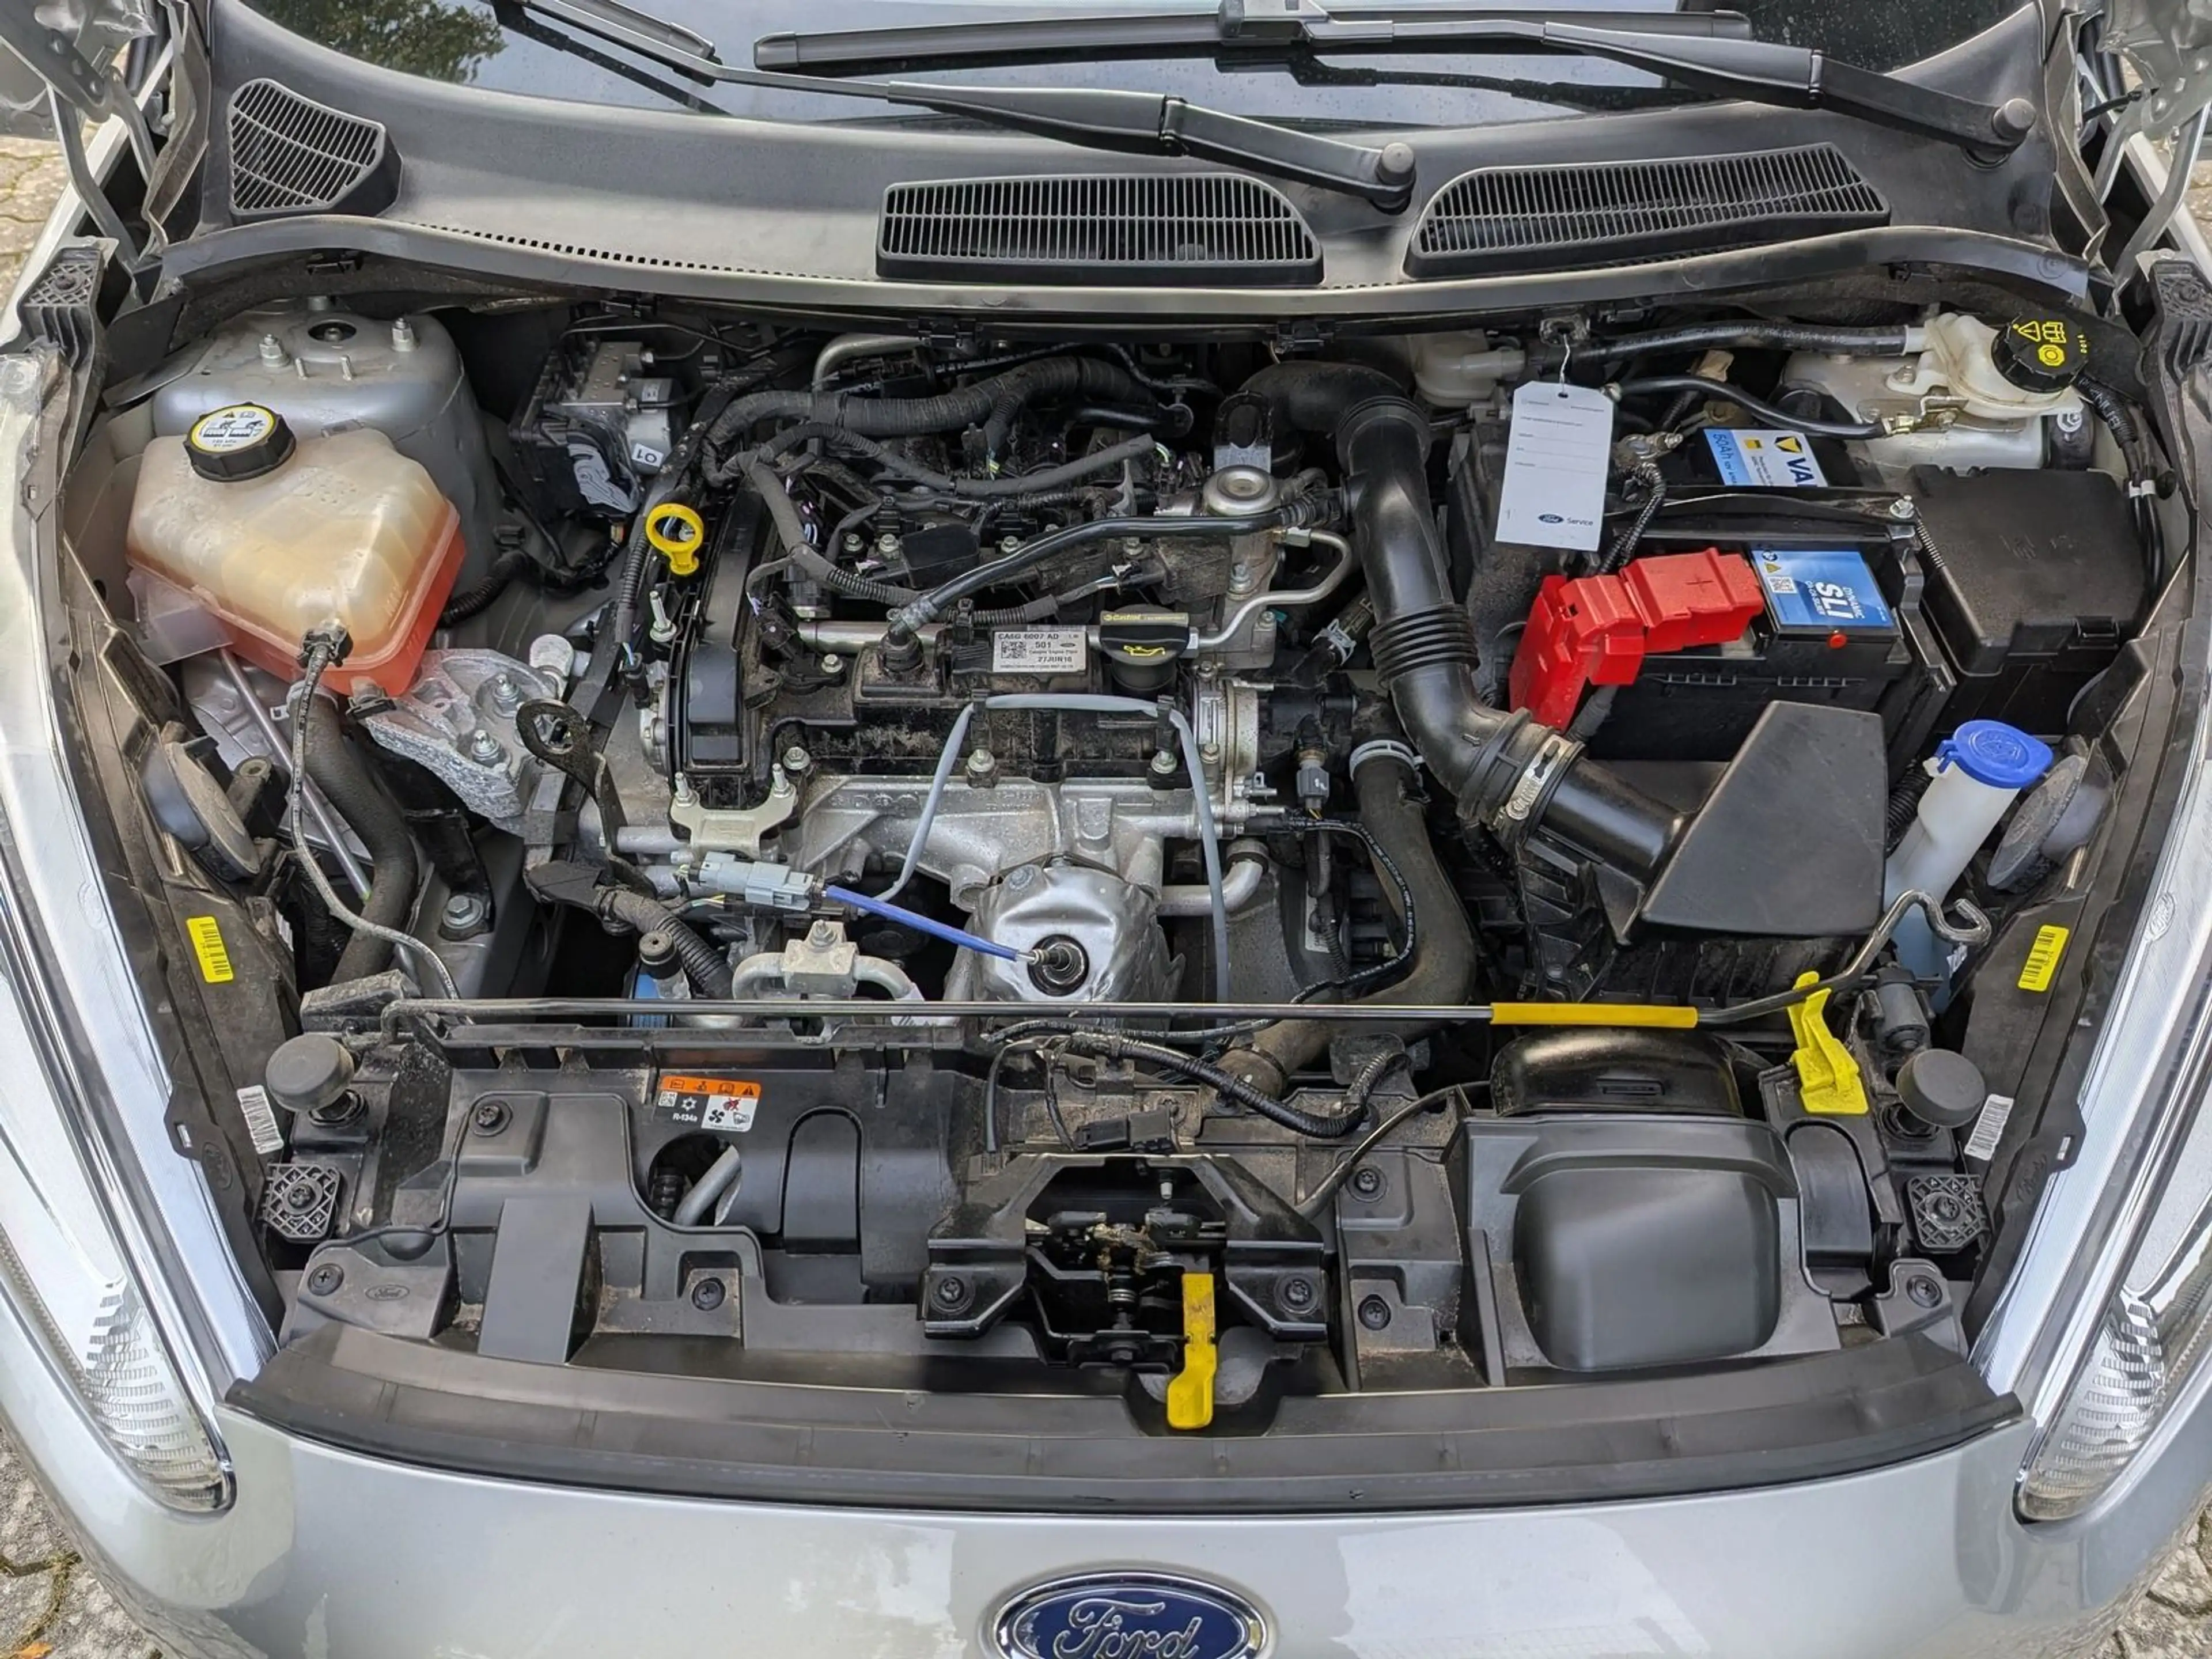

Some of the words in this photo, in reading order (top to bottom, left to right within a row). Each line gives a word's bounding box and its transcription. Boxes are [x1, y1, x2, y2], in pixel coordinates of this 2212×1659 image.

[1567, 517, 1593, 527] Service
[1815, 581, 1854, 619] SLI
[1054, 1598, 1203, 1659] Ford
